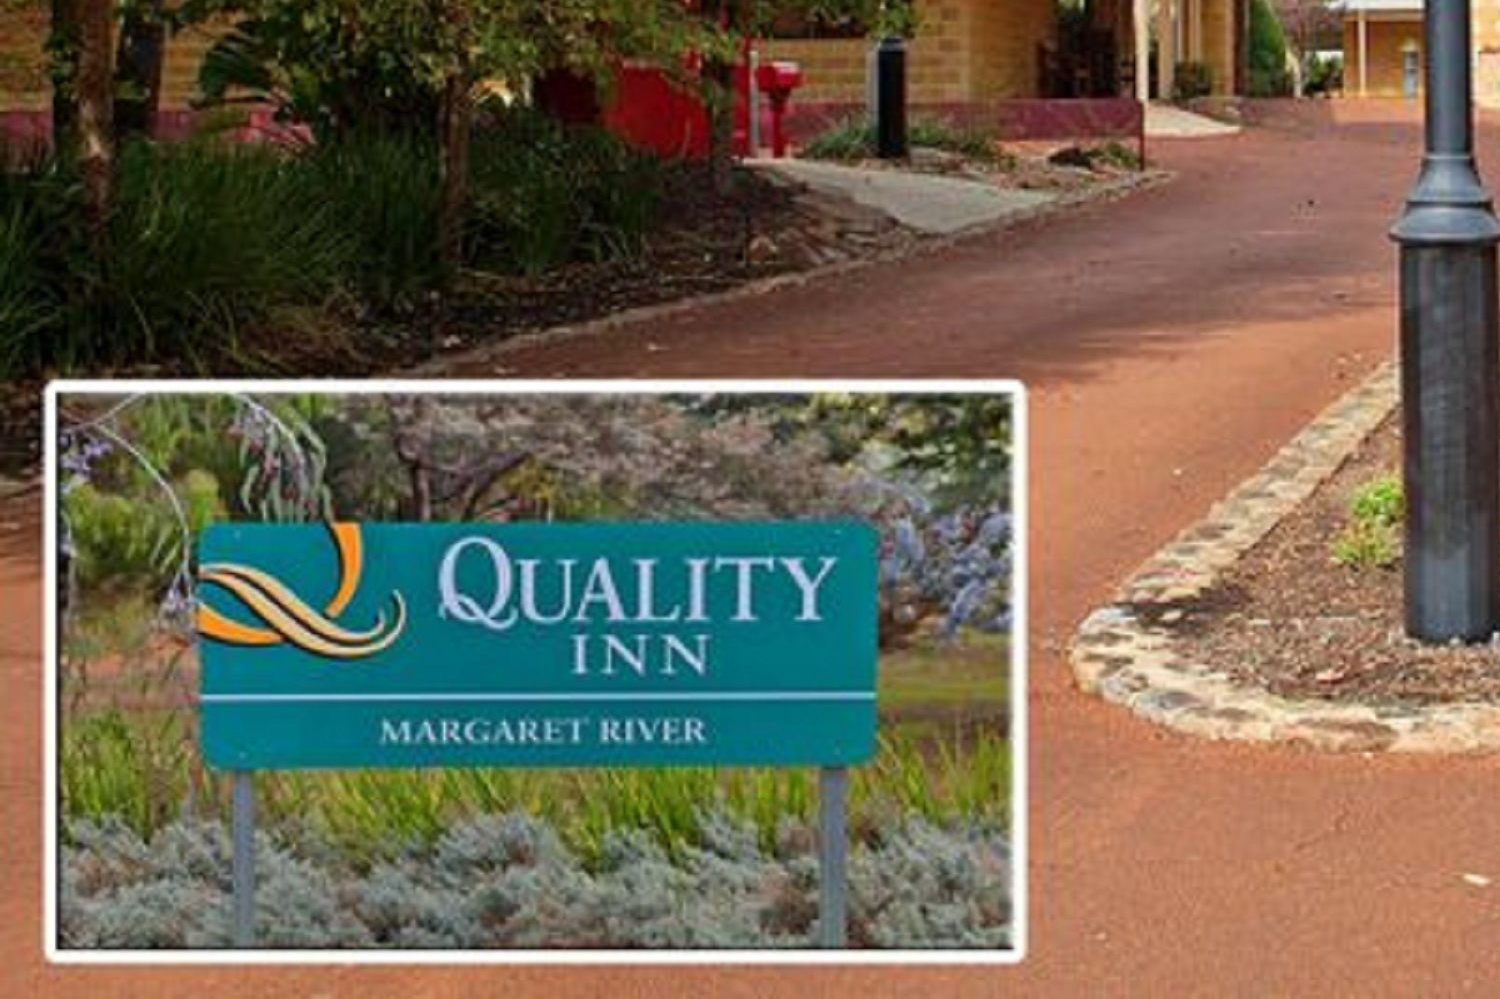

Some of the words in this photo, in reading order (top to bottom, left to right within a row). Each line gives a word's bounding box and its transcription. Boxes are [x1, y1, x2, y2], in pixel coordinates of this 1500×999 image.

[438, 535, 838, 631] QUALITY
[571, 633, 711, 676] INN
[379, 715, 591, 745] MARGARET
[600, 715, 707, 744] RIVER
